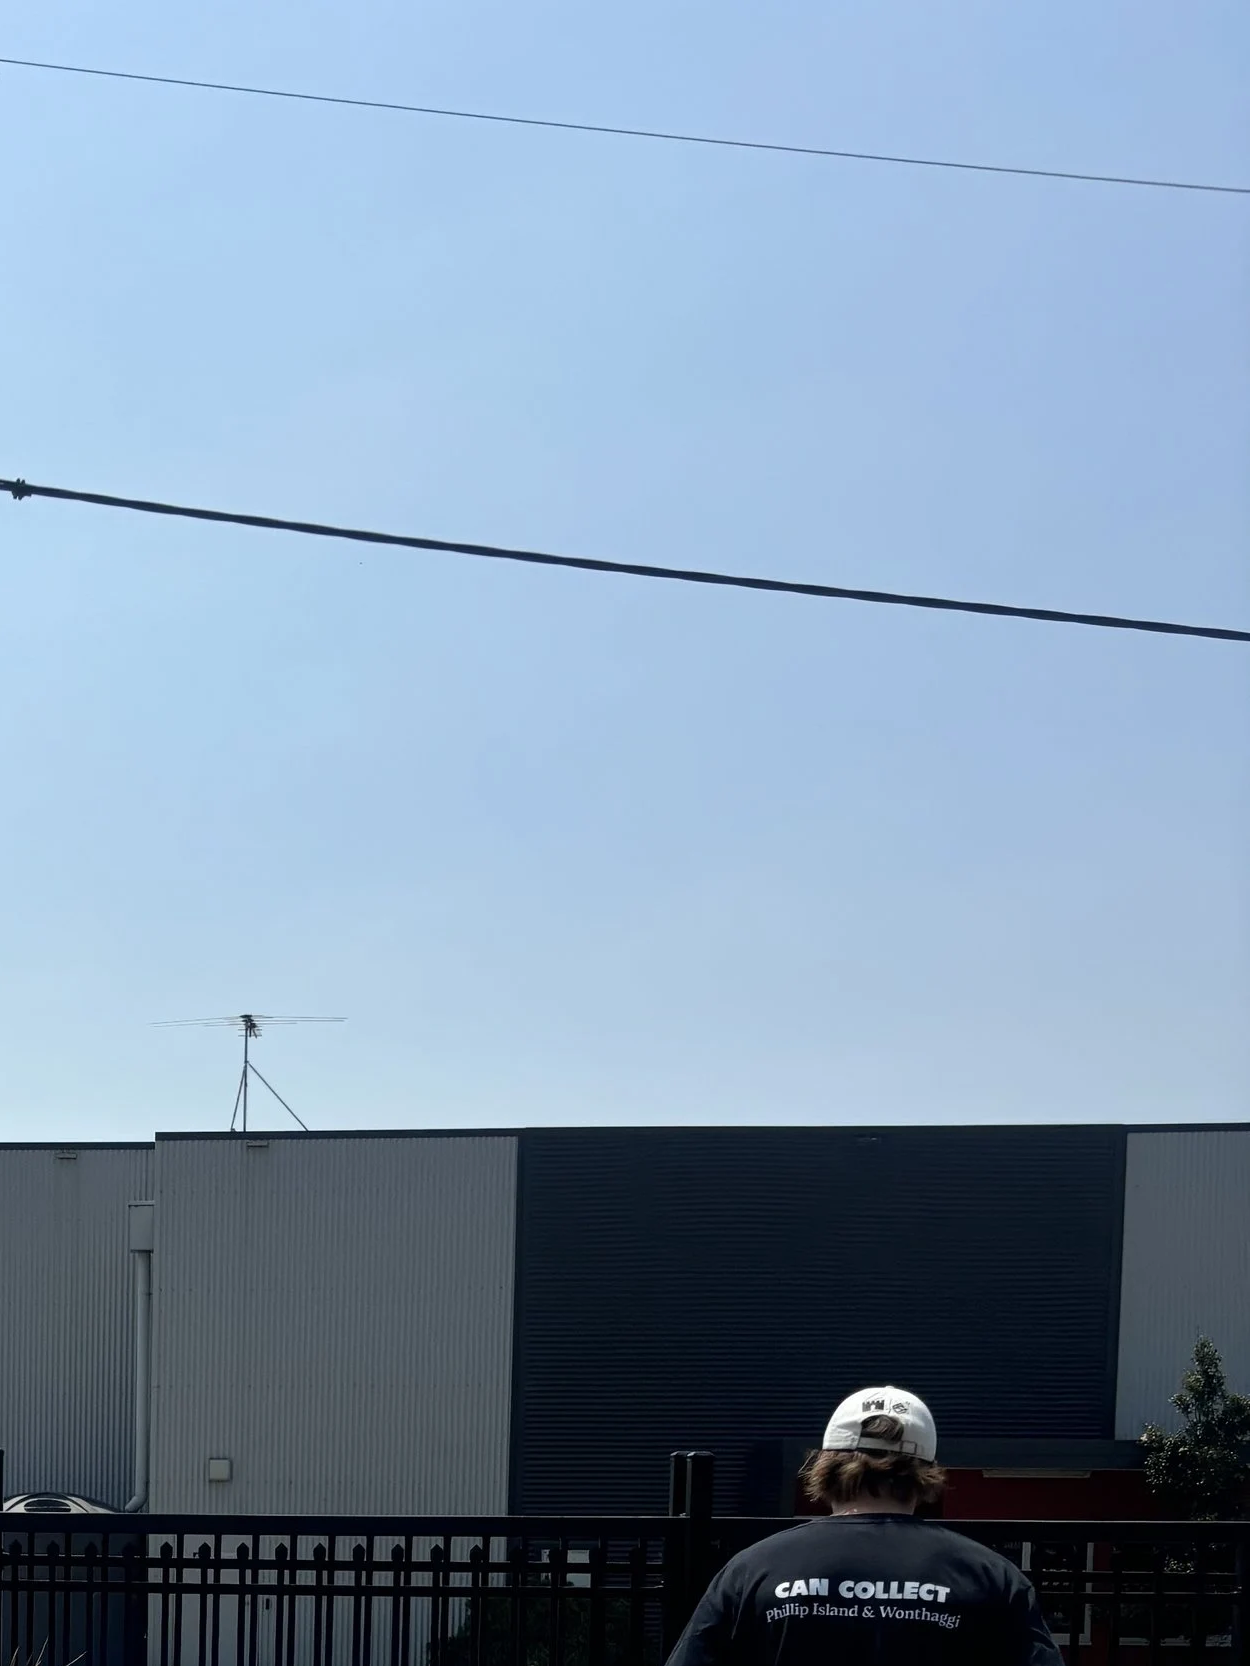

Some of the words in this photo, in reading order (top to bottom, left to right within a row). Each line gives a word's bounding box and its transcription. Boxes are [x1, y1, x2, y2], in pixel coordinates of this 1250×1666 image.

[774, 1578, 829, 1599] CAN
[838, 1580, 950, 1603] COLLECT
[766, 1603, 809, 1623] Phillip
[812, 1602, 858, 1617] Island
[862, 1605, 875, 1618] &
[879, 1605, 961, 1629] Wonthaggi
